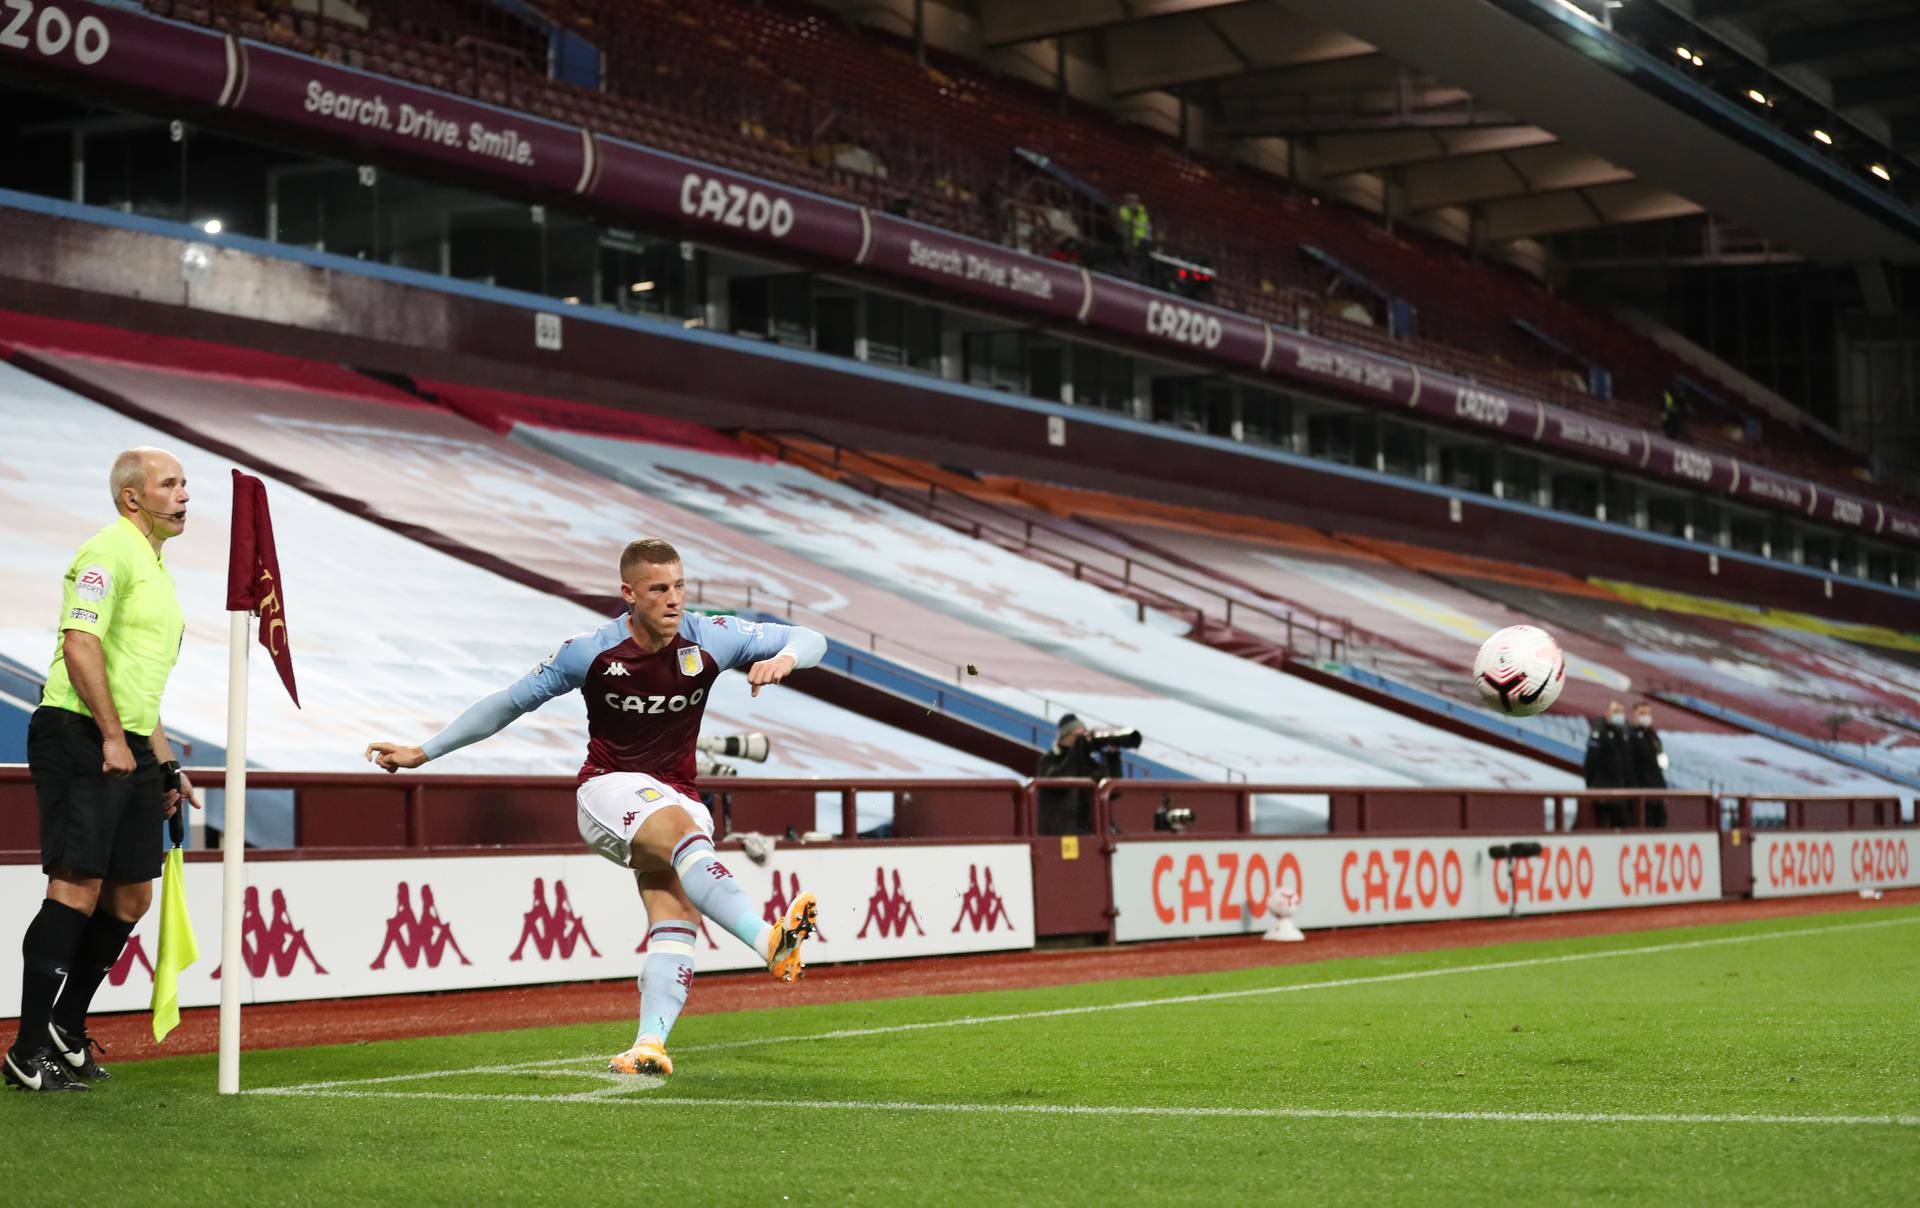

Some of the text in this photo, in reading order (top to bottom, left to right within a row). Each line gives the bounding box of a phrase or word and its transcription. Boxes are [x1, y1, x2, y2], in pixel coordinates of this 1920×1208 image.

[170, 119, 183, 142] 9
[304, 79, 535, 166] Search. Drive. Smile.
[680, 173, 795, 238] CAZOO
[1147, 301, 1222, 350] CAZOO
[82, 571, 104, 588] EA
[604, 688, 705, 715] CAZOO
[1340, 848, 1463, 914] CAZOO
[1492, 846, 1594, 906] CAZOO
[1618, 842, 1703, 897] CAZOO
[1768, 840, 1834, 889] CAZOO
[1852, 838, 1909, 883] CAZOO
[1152, 852, 1303, 925] CAZOO
